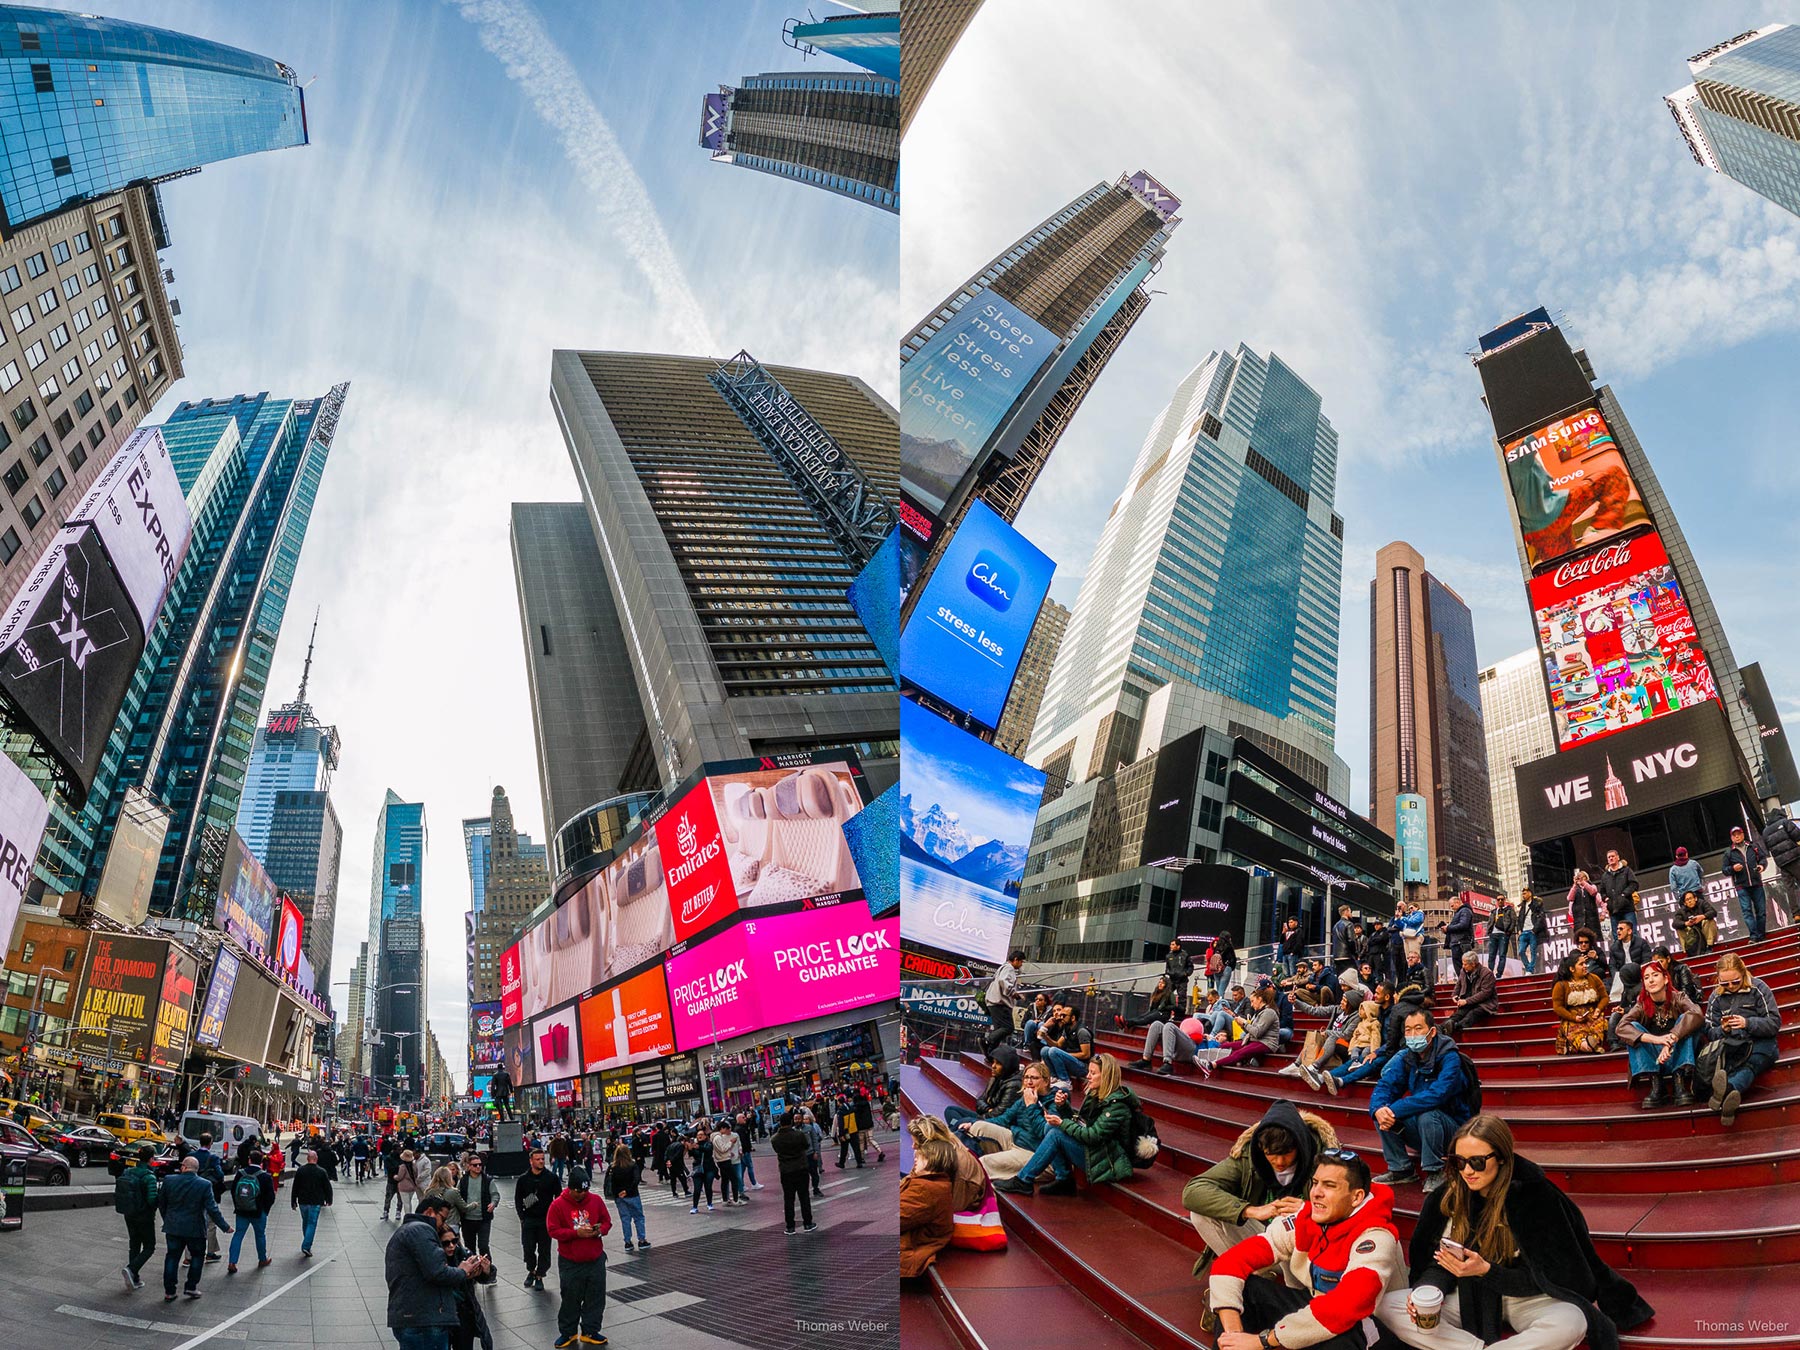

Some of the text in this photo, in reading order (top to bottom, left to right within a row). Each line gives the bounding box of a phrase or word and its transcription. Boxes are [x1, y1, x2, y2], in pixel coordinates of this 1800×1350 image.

[971, 317, 1023, 359] more.
[982, 305, 1034, 346] Sleep
[941, 344, 982, 382] less.
[954, 332, 1013, 378] Stress
[921, 364, 964, 400] Live
[906, 381, 977, 436] better.
[750, 391, 839, 490] AMERICAN EAGLE
[774, 393, 840, 462] OUTFITTERS
[1507, 413, 1600, 462] SAMSUNG
[98, 455, 127, 488] EXPRESS
[1549, 469, 1584, 489] Move
[28, 544, 63, 593] EXPRESS
[1554, 540, 1632, 588] Coca-Cola
[972, 563, 1010, 600] Calm
[937, 605, 1004, 657] stress less
[267, 716, 299, 733] H&M
[777, 752, 812, 761] MARRIOTT
[779, 759, 811, 767] MARQUIS
[1544, 743, 1698, 808] WE NYC
[650, 799, 669, 819] MARRIOTT
[1324, 798, 1338, 814] School
[1322, 831, 1335, 847] World
[668, 839, 720, 887] Emirates
[683, 885, 715, 916] FLY BETTER
[815, 893, 841, 902] MARRIOTT
[816, 899, 840, 907] MARQUIS
[1201, 900, 1229, 911] Stanley
[933, 902, 991, 940] Calm
[97, 940, 113, 957] THE
[773, 929, 892, 971] PRICE LOCK
[93, 956, 157, 979] NEIL DIAMOND
[799, 954, 879, 983] GUARANTEE
[904, 954, 956, 979] CAMINOS
[89, 972, 123, 991] MUSICAL
[674, 958, 748, 1006] PRICE LOCK
[83, 988, 145, 1019] A BEAUTIFUL
[687, 986, 738, 1016] GUARANTEE
[911, 987, 952, 1008] NOW
[79, 1010, 110, 1037] NOISE
[201, 1014, 215, 1034] LIFE
[628, 1012, 662, 1028] ACTIVATING SERUM
[637, 1008, 647, 1017] CARE
[919, 1004, 933, 1012] FOR
[934, 1007, 957, 1017] LUNCH
[964, 1013, 988, 1023] DINNER
[643, 1023, 658, 1034] EDITION
[604, 1083, 631, 1098] 50% OFF
[666, 1083, 694, 1095] SEPHORA
